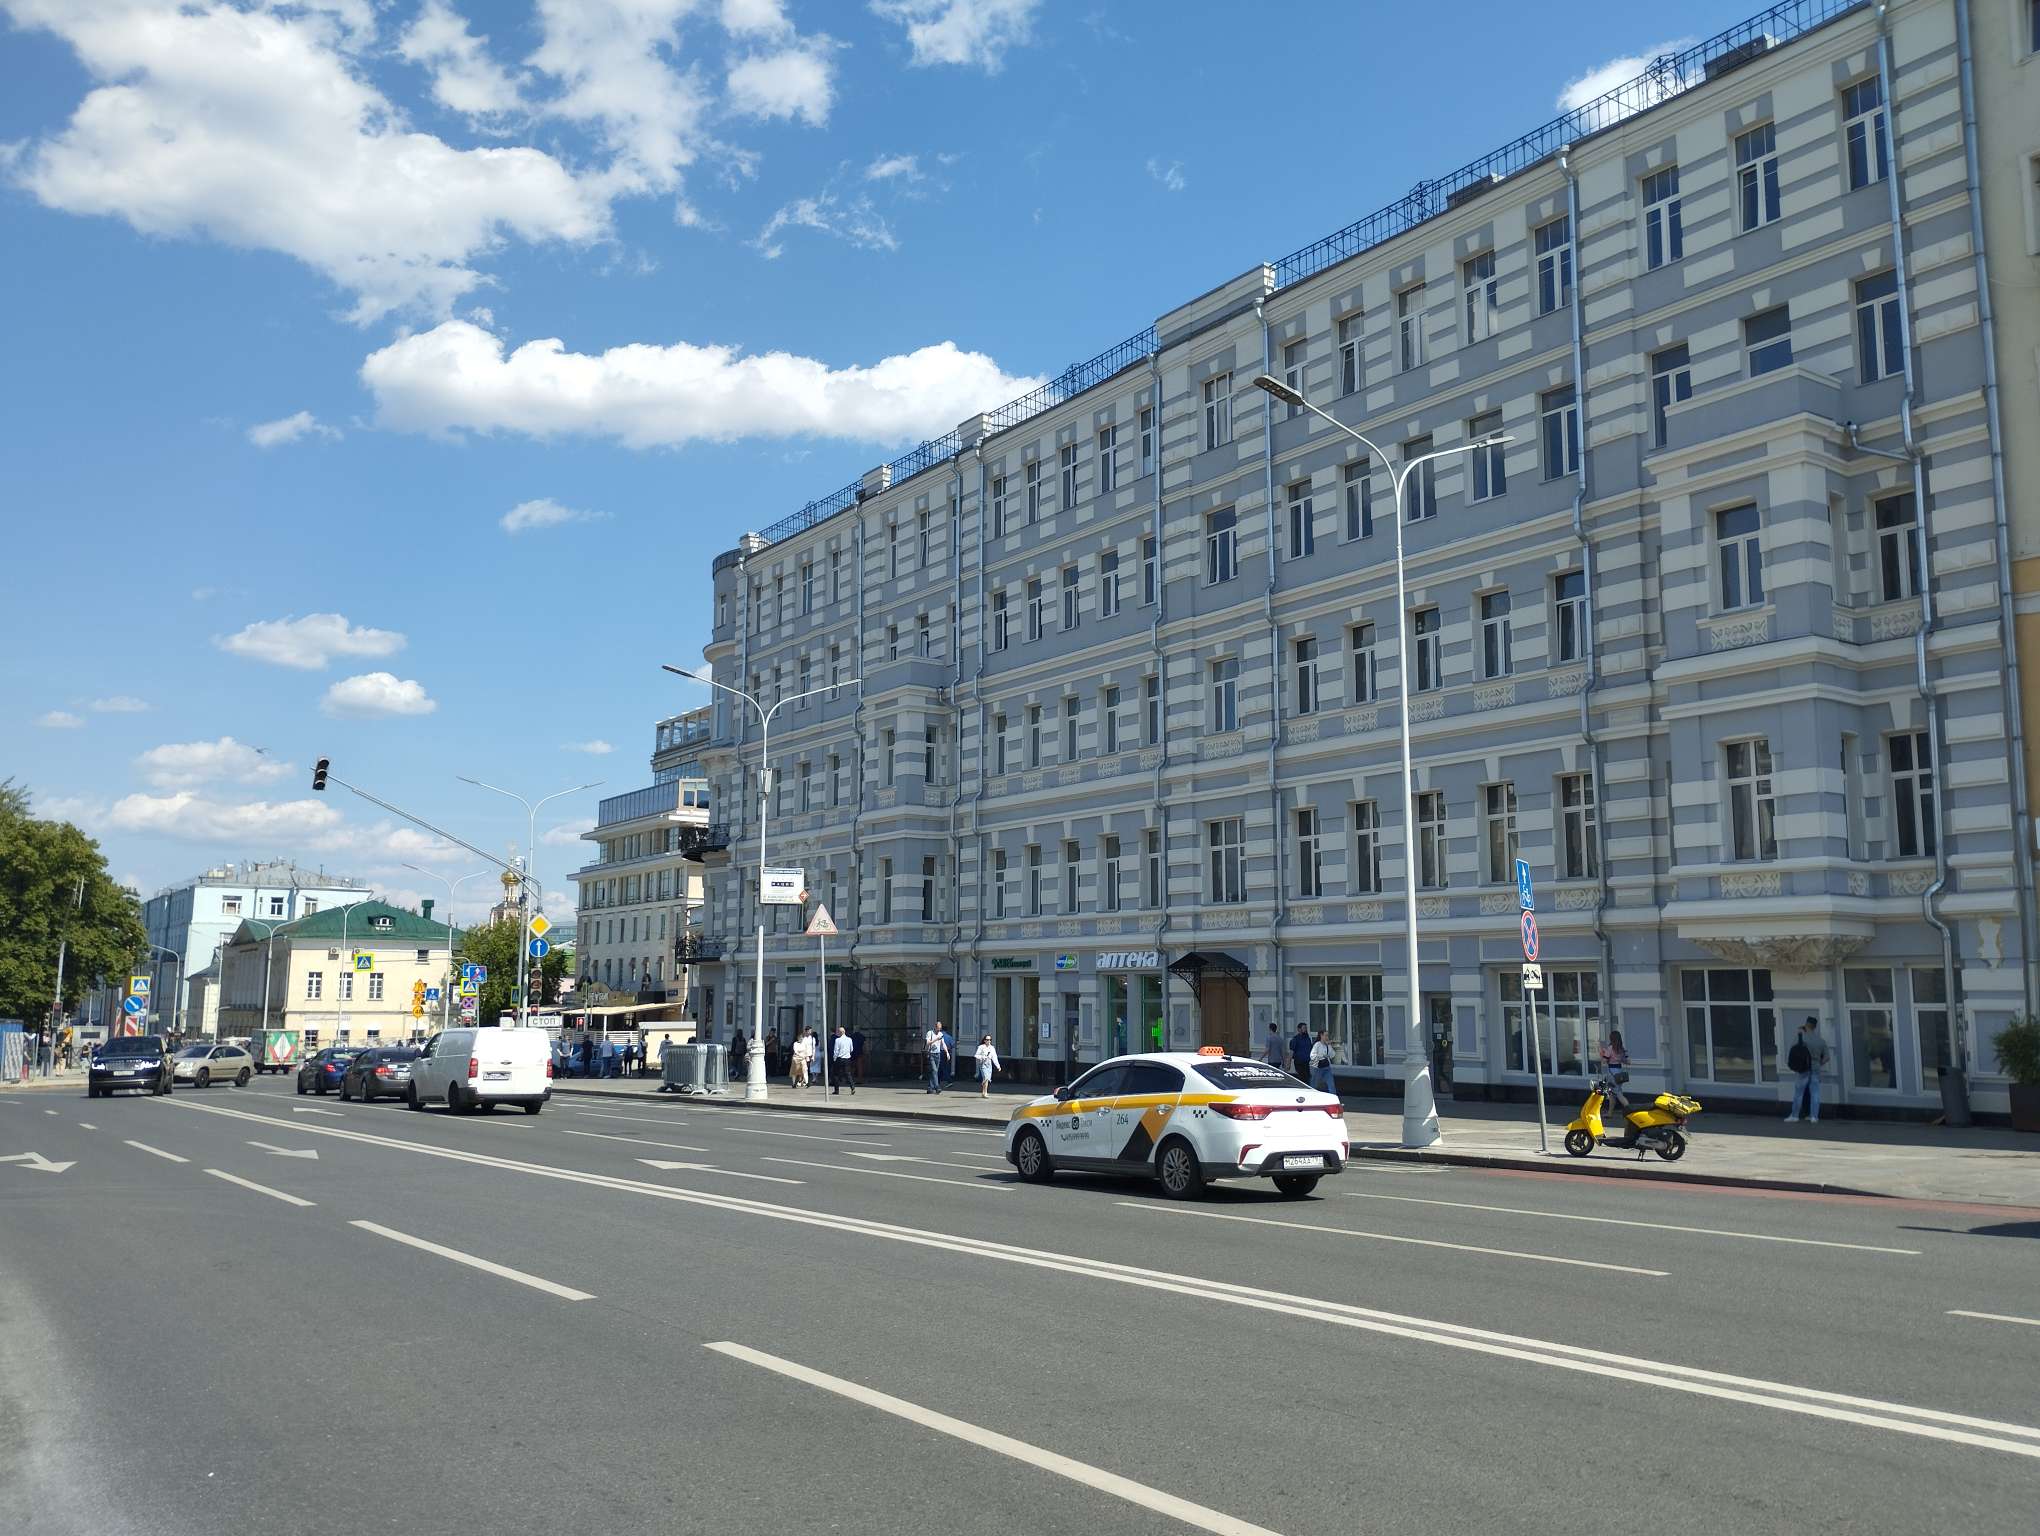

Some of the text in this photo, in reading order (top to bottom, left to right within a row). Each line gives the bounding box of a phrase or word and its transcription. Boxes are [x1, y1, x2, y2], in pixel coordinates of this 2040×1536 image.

[1097, 951, 1158, 968] аптека
[532, 1017, 556, 1025] СТОП
[1116, 1113, 1129, 1125] 264
